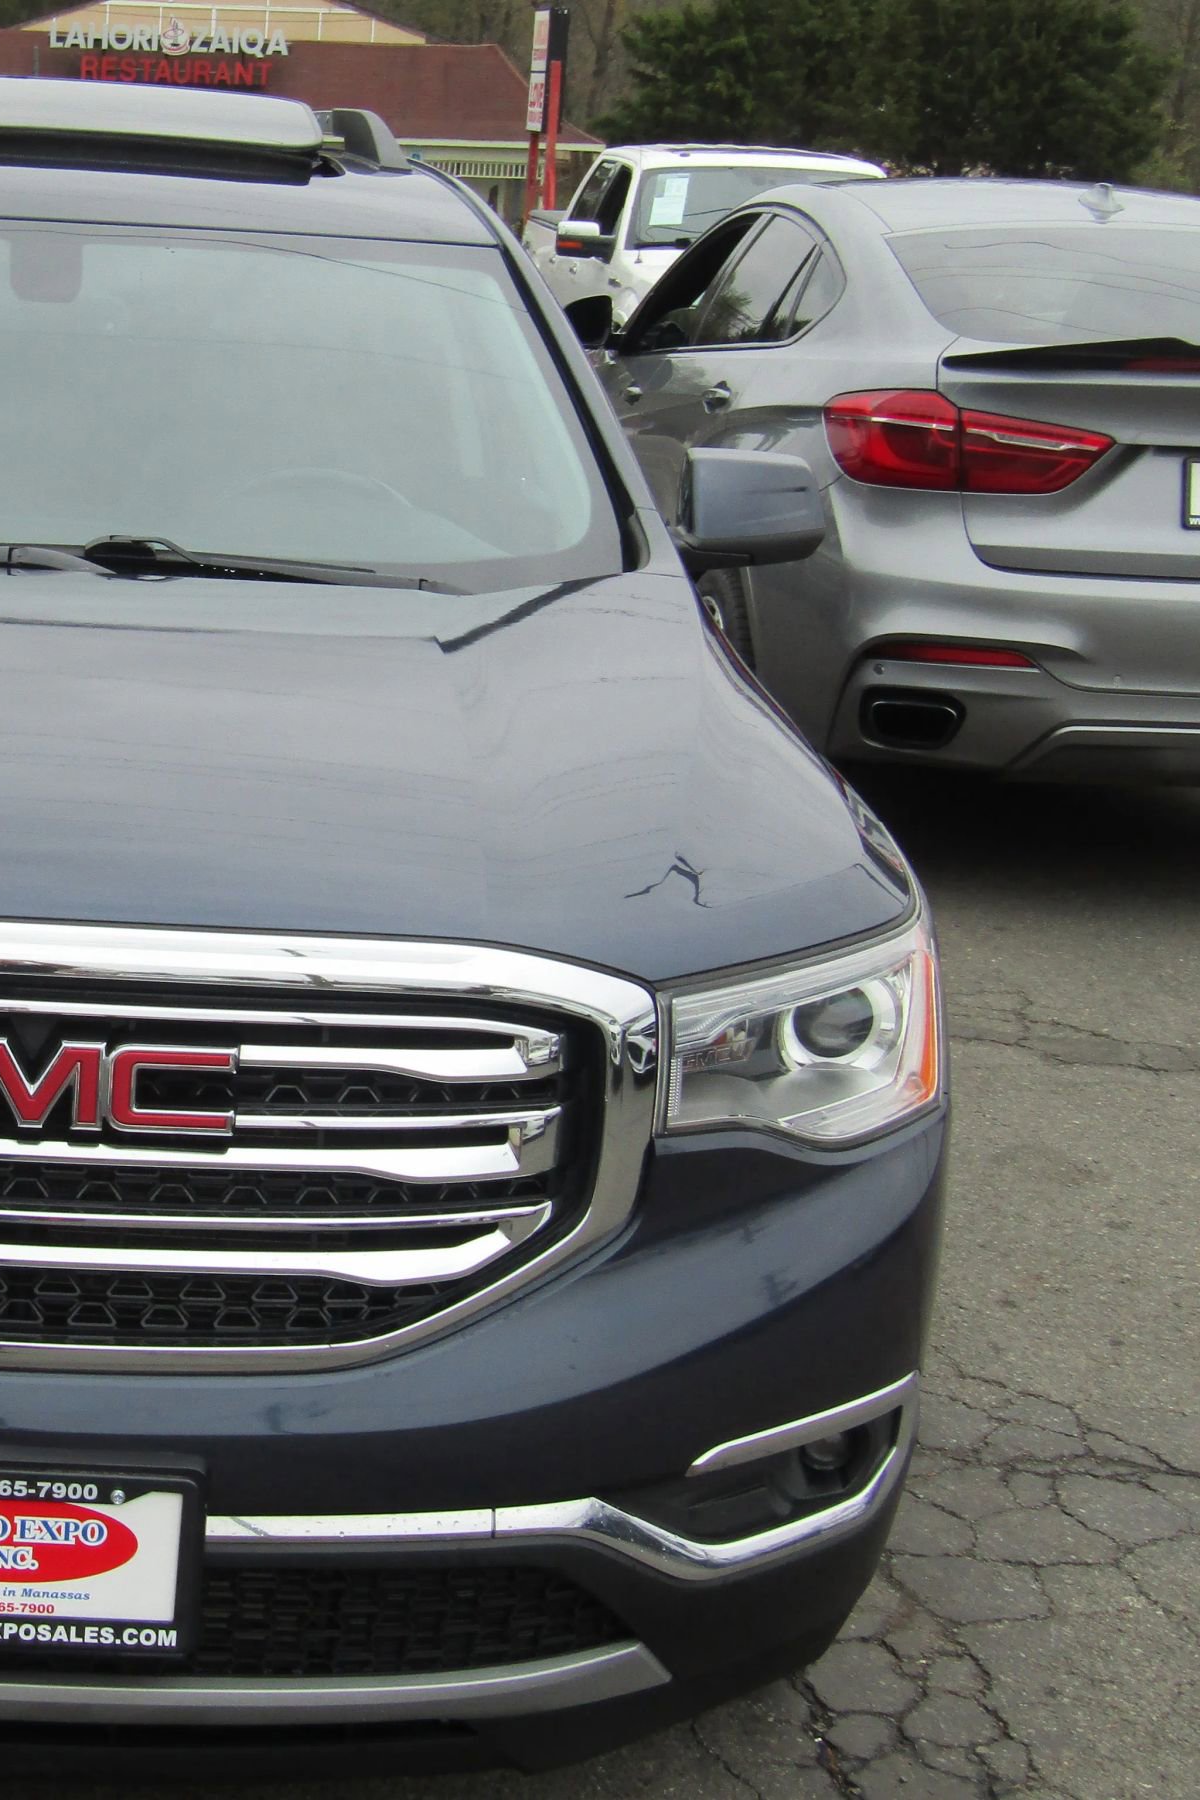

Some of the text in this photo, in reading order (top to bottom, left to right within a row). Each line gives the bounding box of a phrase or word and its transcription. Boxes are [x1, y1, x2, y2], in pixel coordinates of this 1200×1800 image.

[49, 20, 289, 58] LAHORI ZAIQA
[80, 55, 272, 86] RESTAURANT
[13, 1515, 108, 1546] EXPO
[3, 1587, 17, 1597] in
[21, 1588, 91, 1601] Manassas
